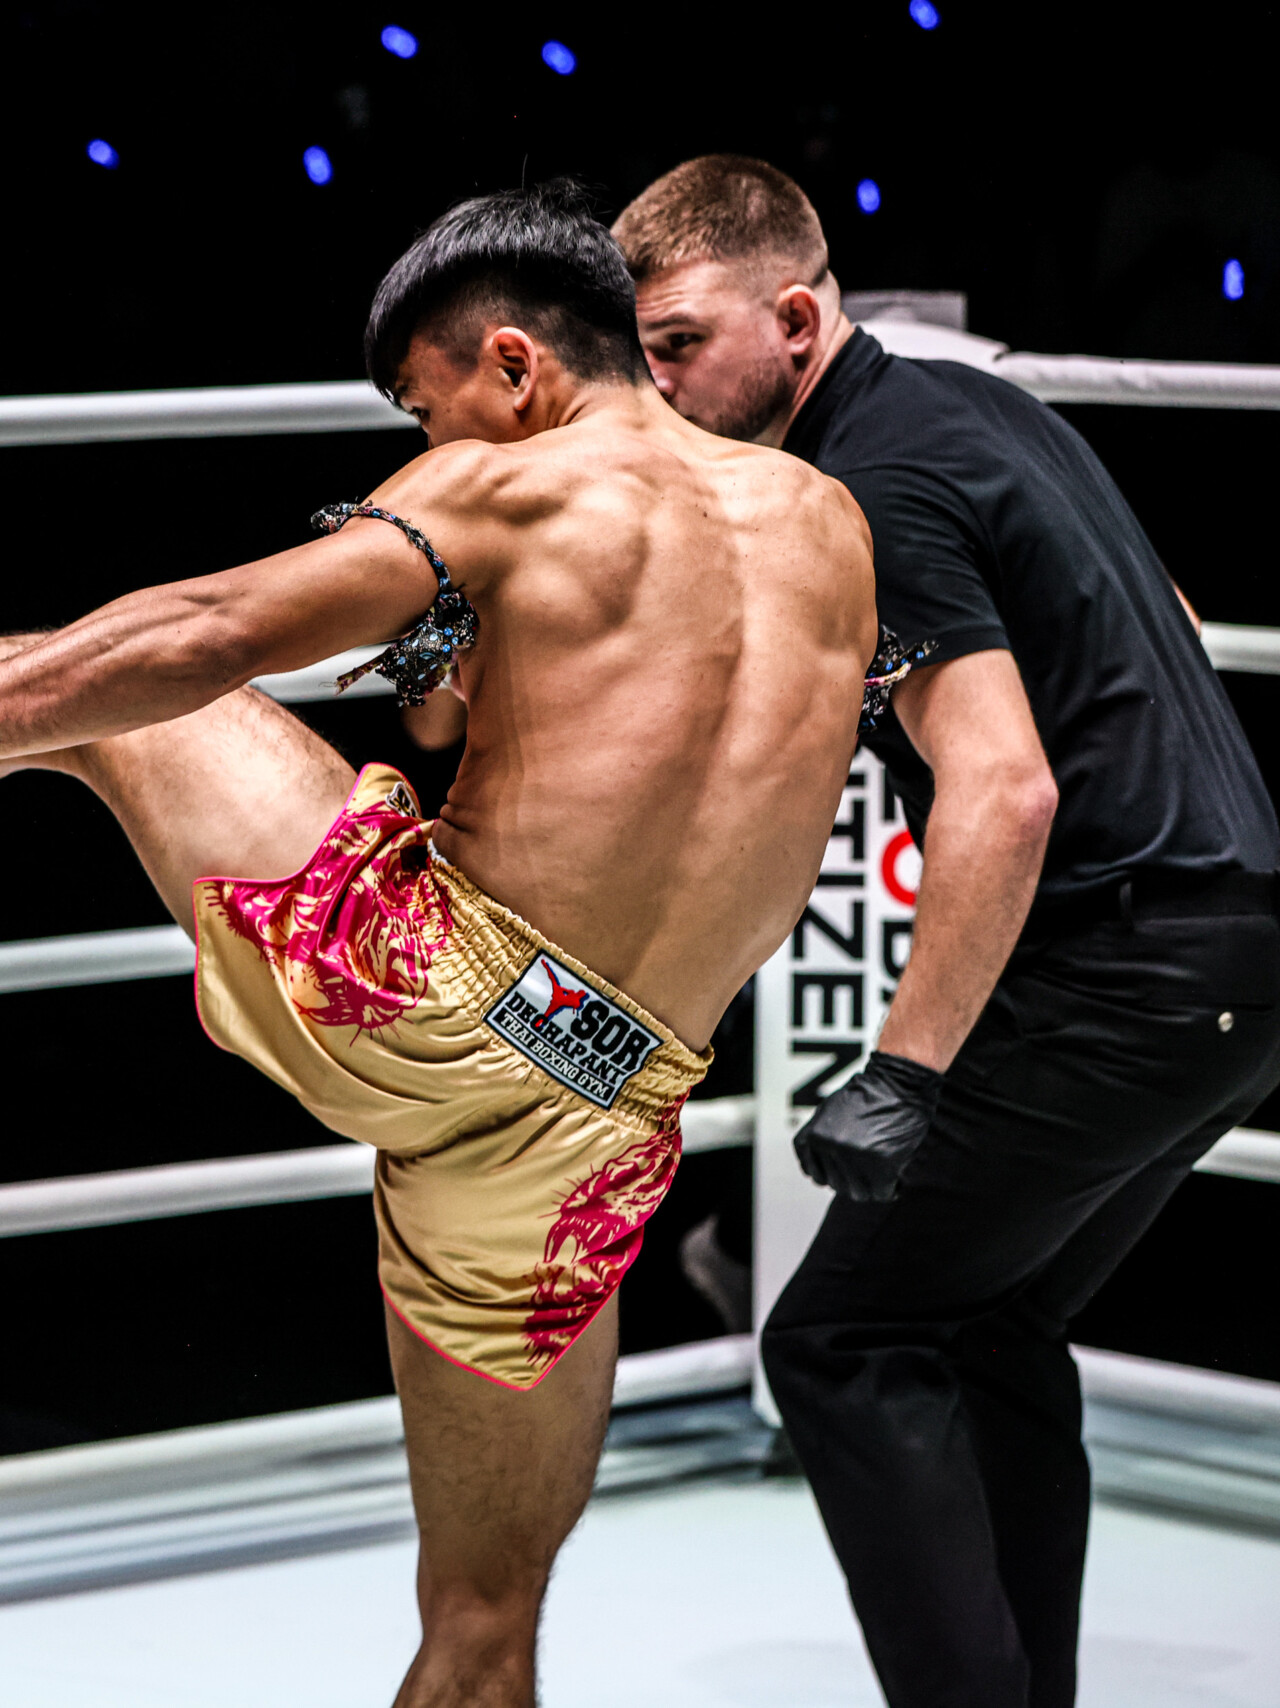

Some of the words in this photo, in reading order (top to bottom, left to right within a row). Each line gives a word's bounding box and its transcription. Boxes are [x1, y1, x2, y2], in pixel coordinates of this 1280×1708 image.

[500, 1013, 534, 1047] THAI
[531, 1040, 579, 1080] BOXING
[577, 1070, 610, 1099] GYM
[506, 992, 626, 1085] DECHAPANT
[570, 999, 651, 1073] SOR
